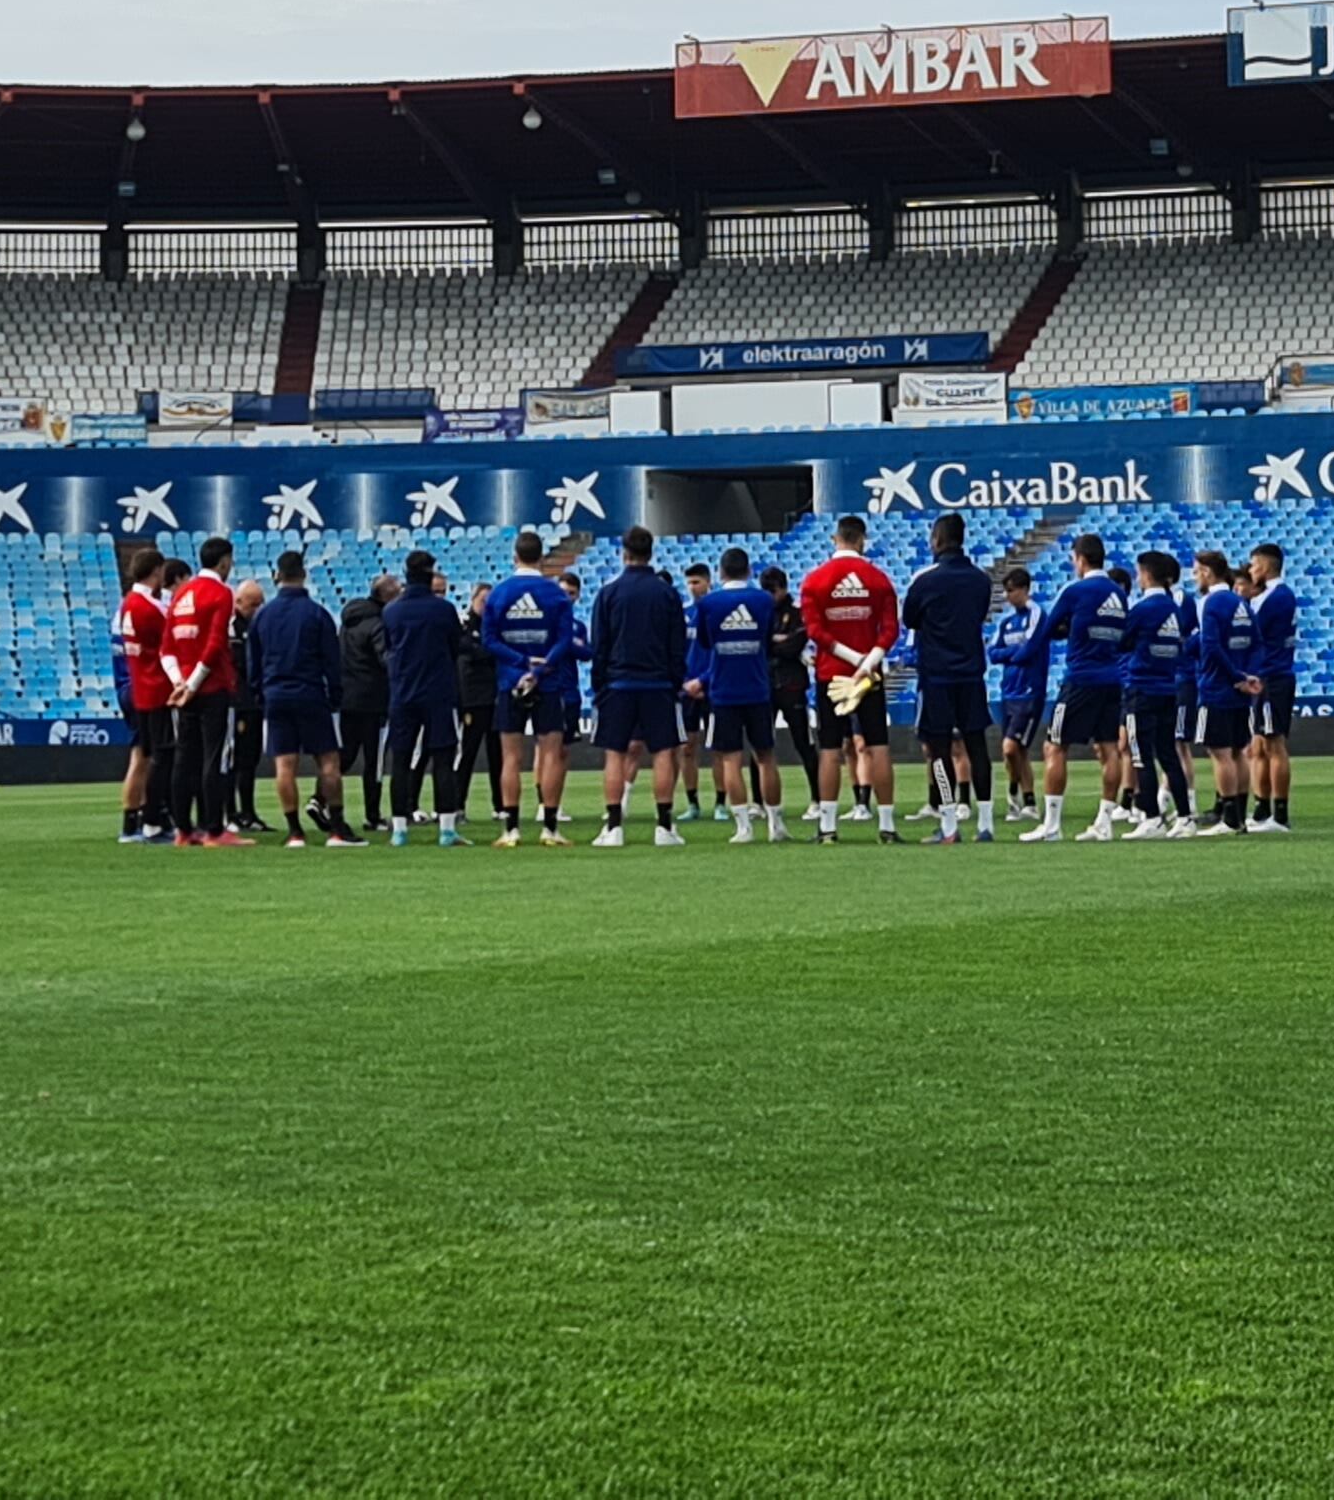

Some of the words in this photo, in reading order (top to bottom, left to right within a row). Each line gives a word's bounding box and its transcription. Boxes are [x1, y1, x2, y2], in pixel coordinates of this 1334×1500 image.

[806, 31, 1052, 100] AMBAR
[742, 342, 886, 365] elektraaragón
[1037, 403, 1079, 414] VILLA
[1083, 401, 1101, 413] DE
[929, 459, 1152, 508] CaixaBank
